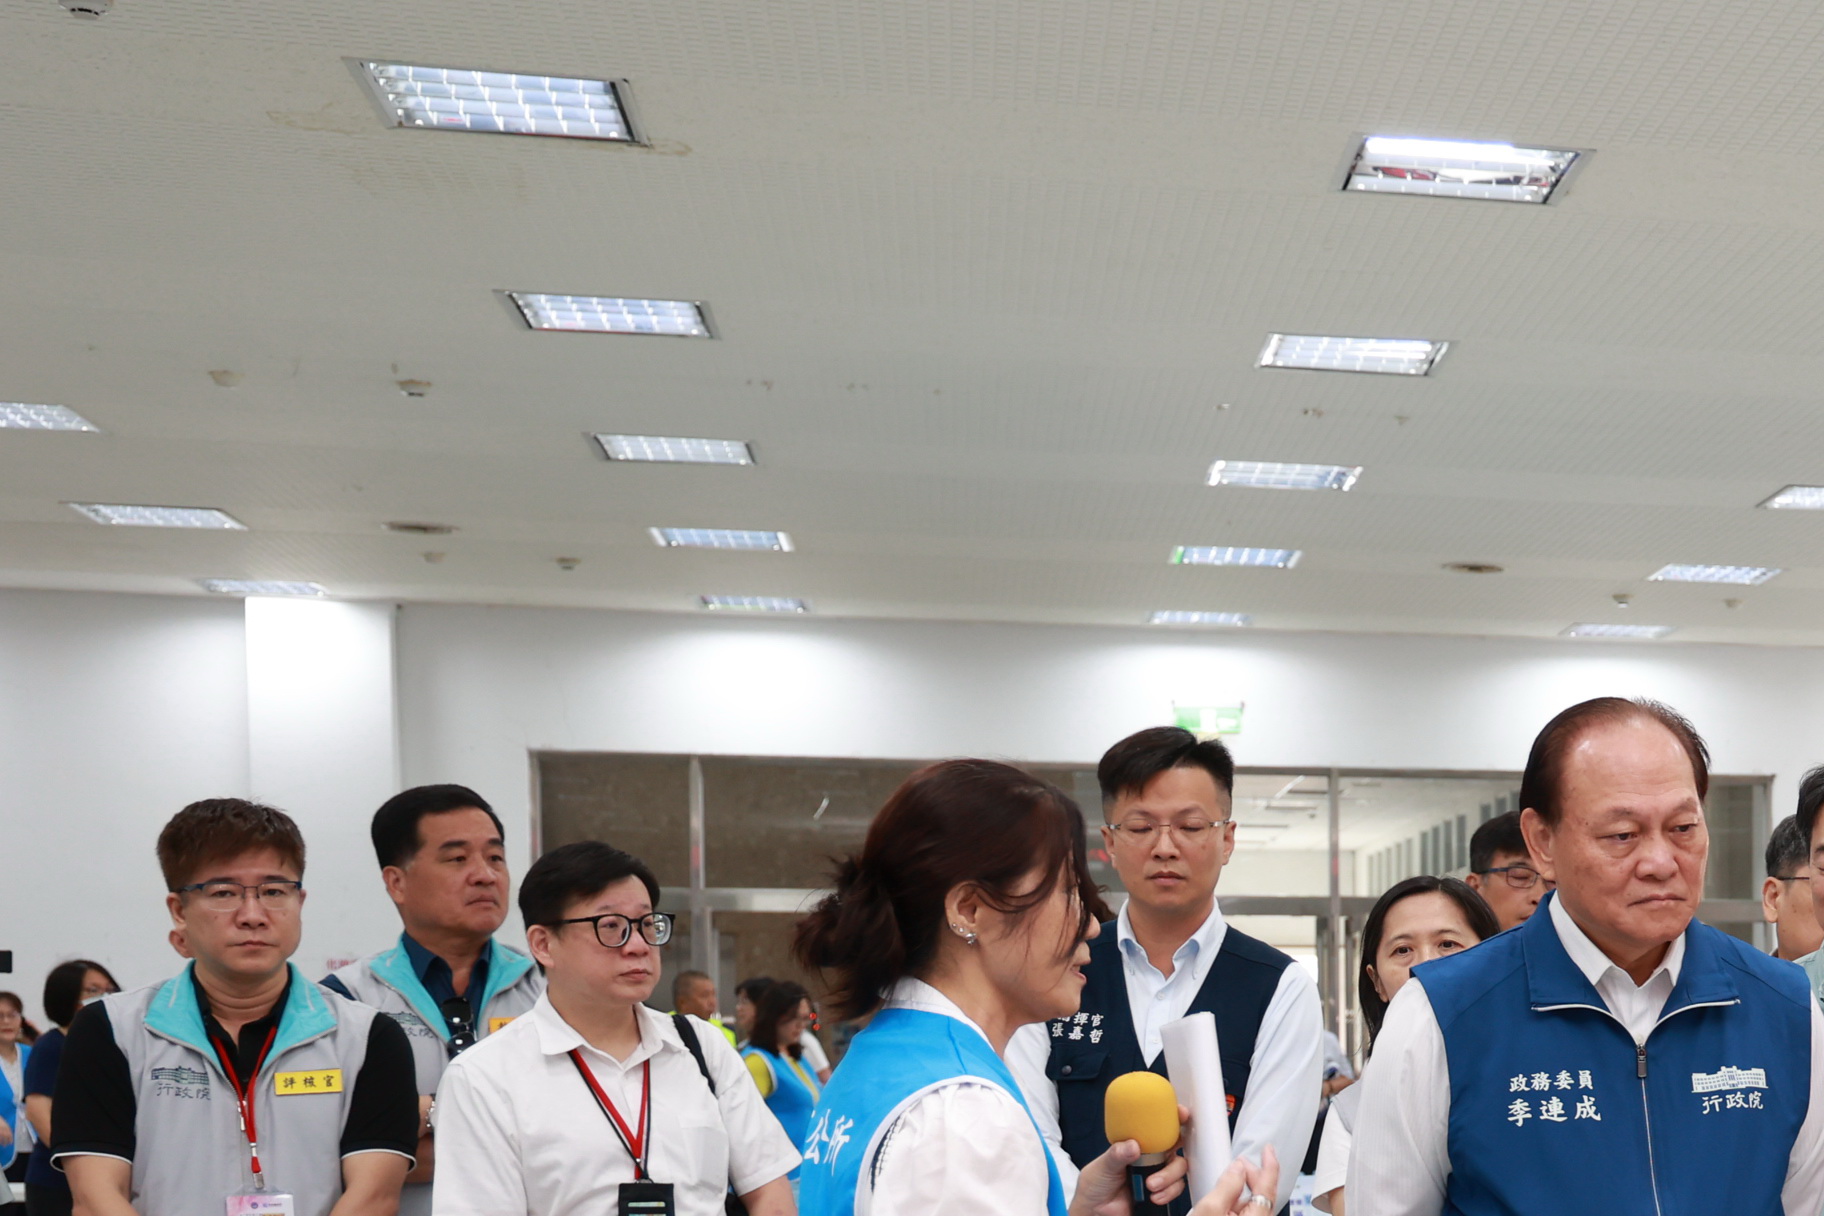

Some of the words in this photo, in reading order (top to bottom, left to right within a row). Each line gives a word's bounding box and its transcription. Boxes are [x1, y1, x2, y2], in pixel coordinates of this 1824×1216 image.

[1058, 1012, 1104, 1027] 揮官
[157, 1083, 211, 1100] 行政院
[1509, 1070, 1594, 1093] 政務委員
[1507, 1095, 1602, 1127] 季連成
[1702, 1091, 1764, 1115] 行政院
[804, 1109, 854, 1176] 公所
